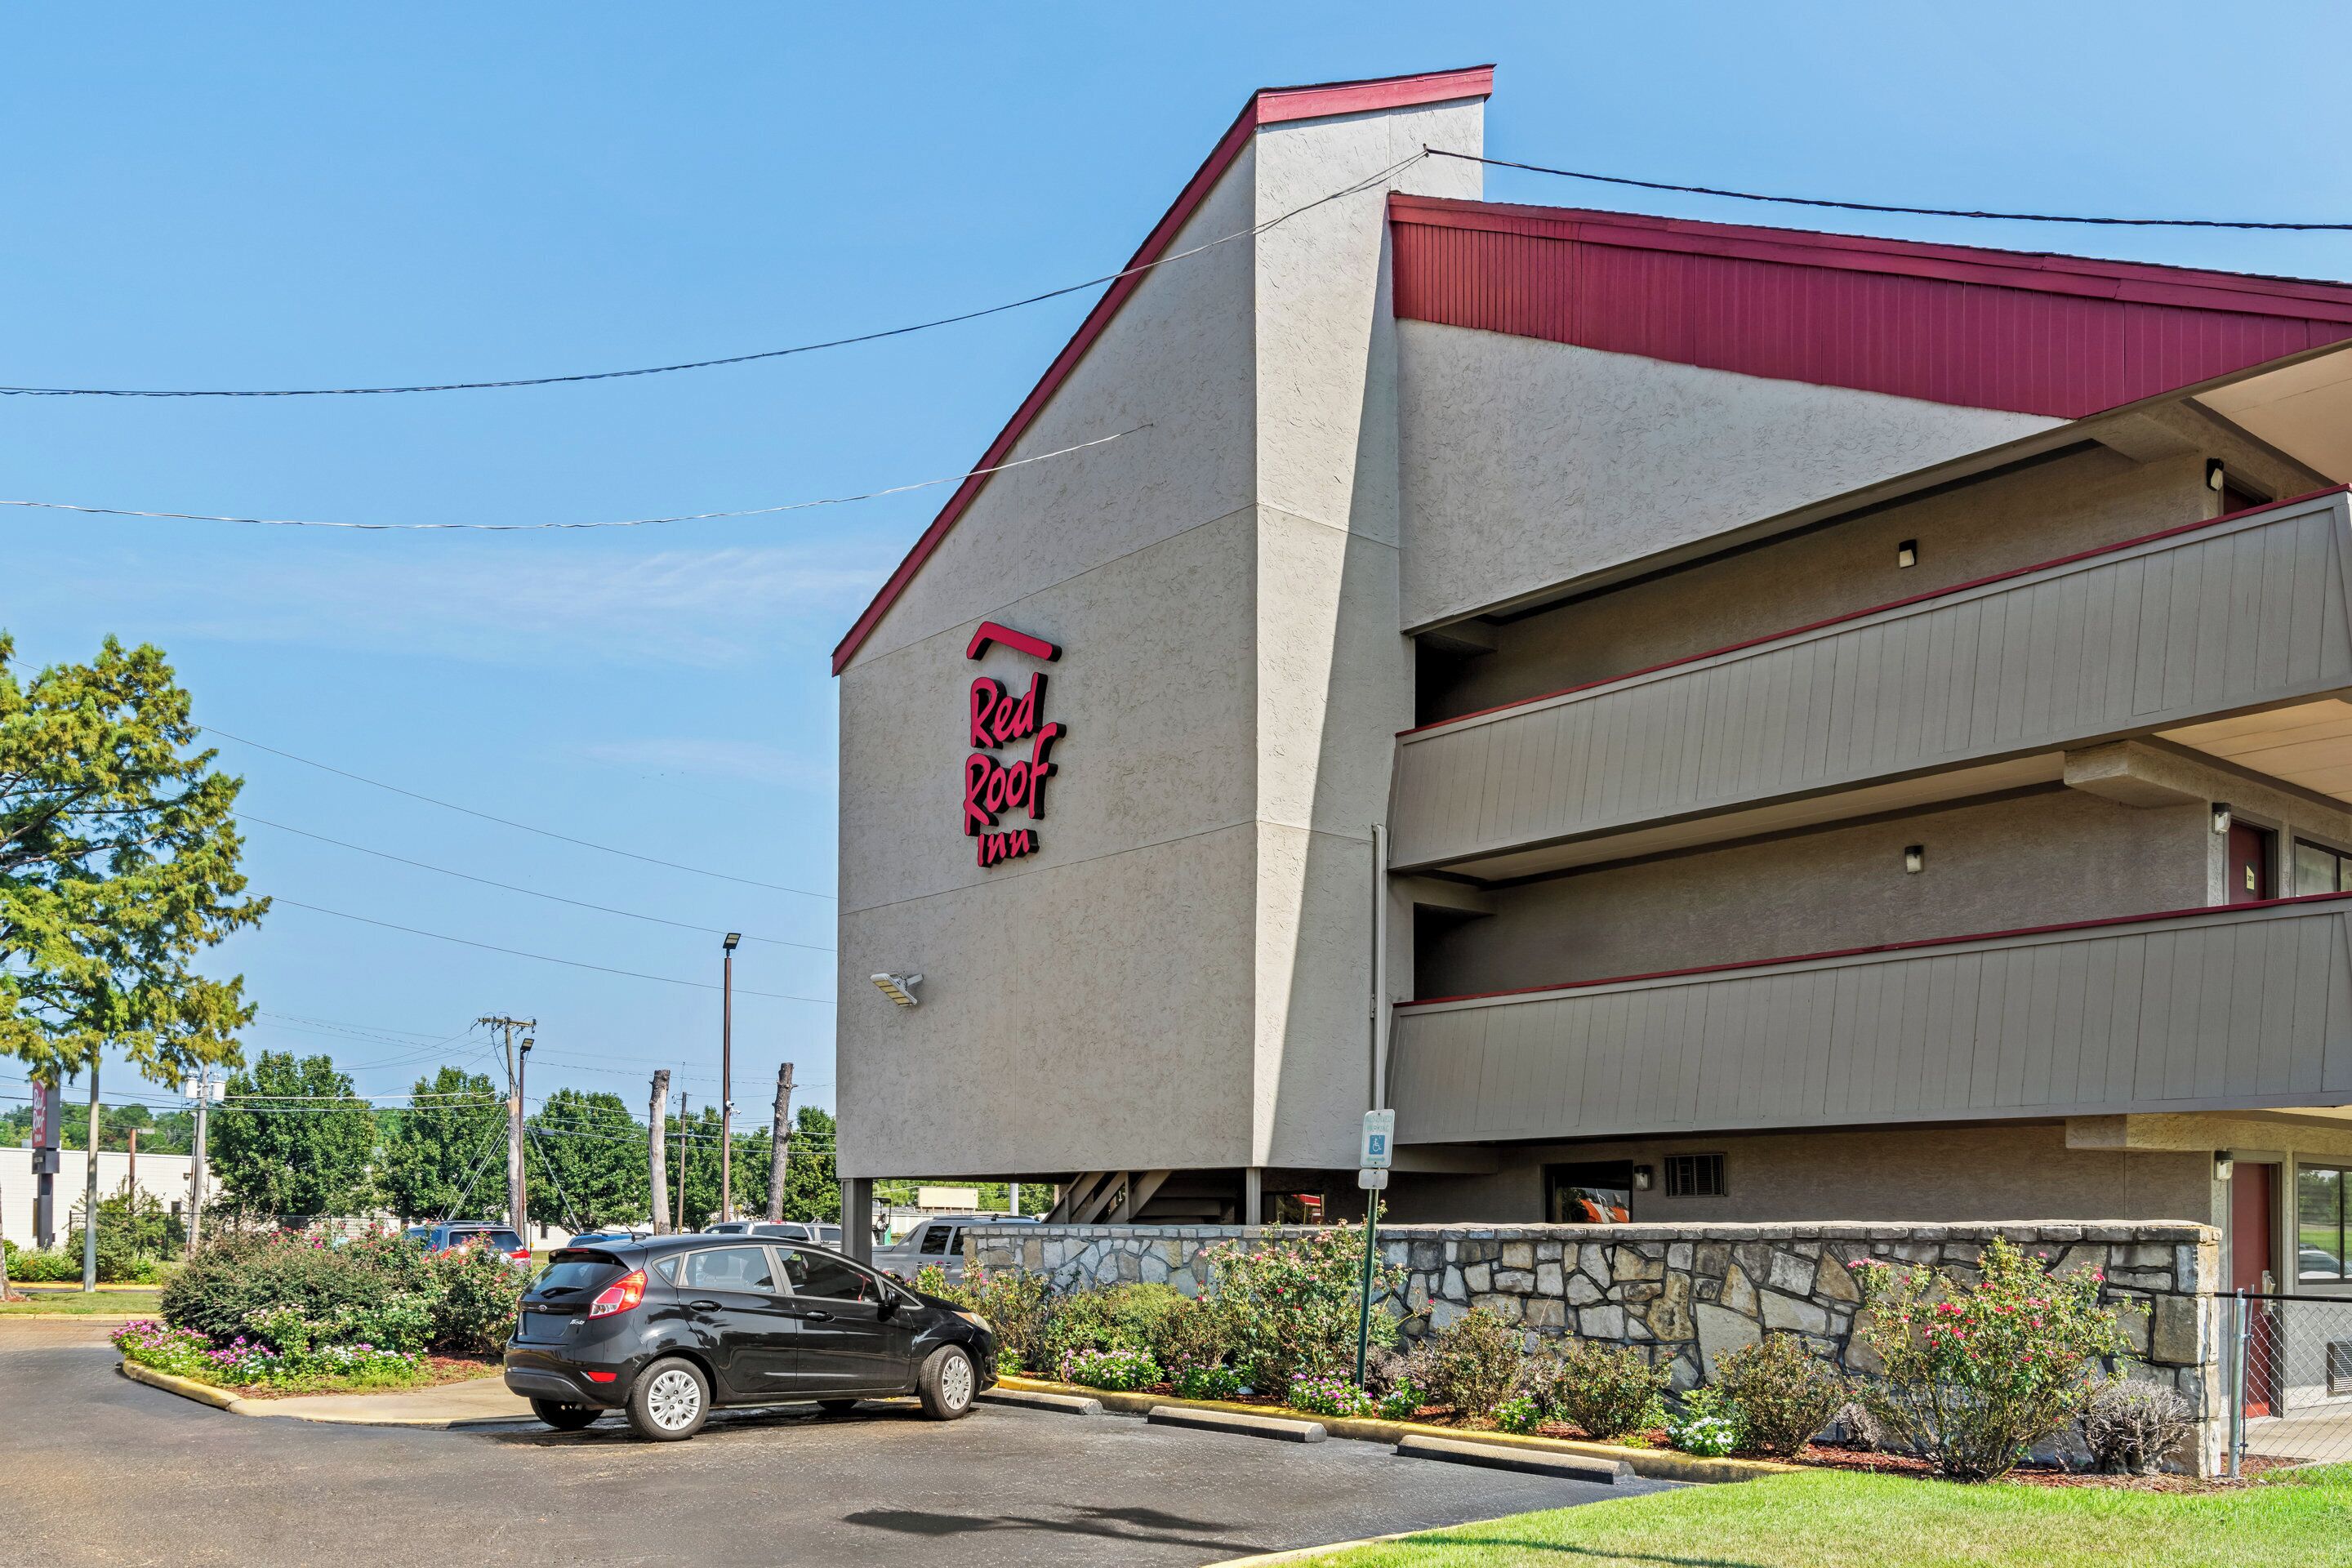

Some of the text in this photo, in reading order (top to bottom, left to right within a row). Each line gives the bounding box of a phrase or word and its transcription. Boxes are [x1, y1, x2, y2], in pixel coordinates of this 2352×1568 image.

[969, 671, 1048, 749] Red
[964, 722, 1067, 836] Roof
[33, 1089, 44, 1110] Red
[33, 1107, 46, 1134] Roof
